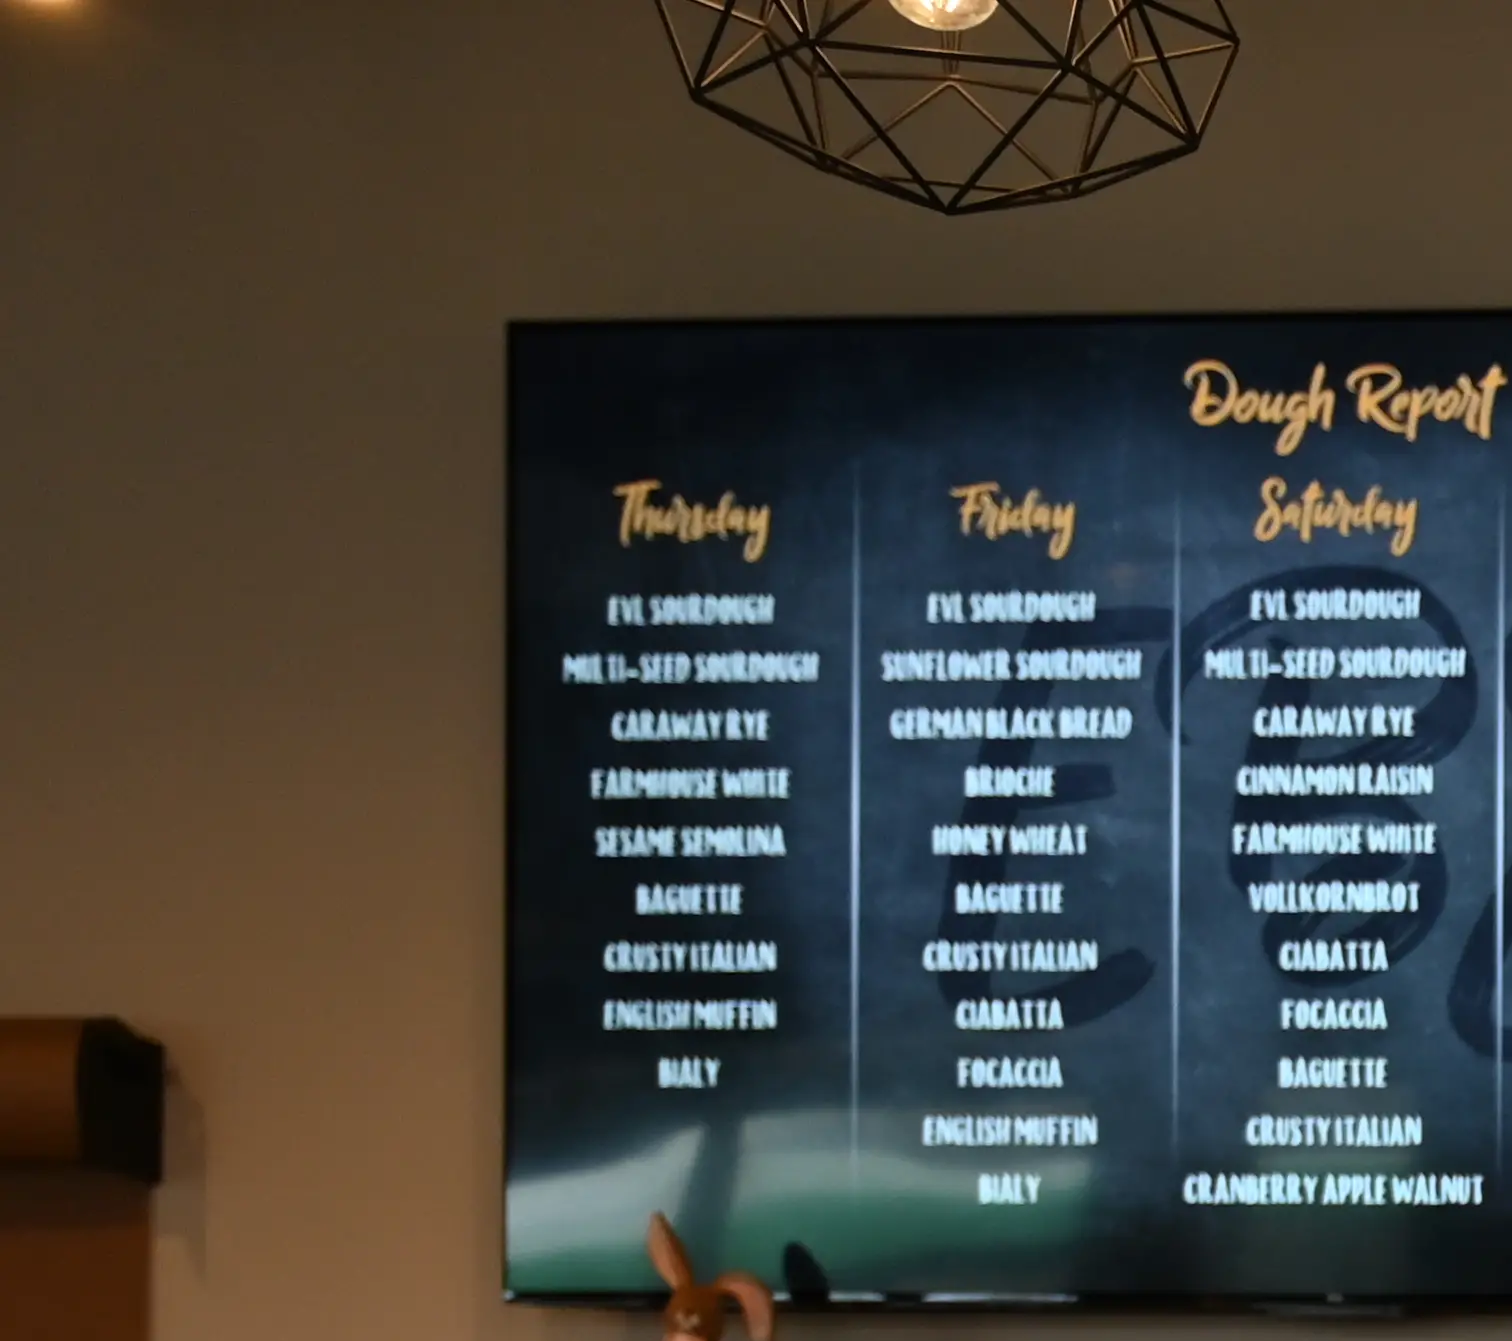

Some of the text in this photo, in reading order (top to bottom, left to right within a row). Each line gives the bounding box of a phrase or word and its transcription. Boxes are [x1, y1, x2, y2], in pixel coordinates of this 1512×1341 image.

[1185, 358, 1509, 458] Dough Report
[613, 479, 769, 563] Thursday
[951, 480, 1077, 561] Friday
[1255, 475, 1418, 558] Saturday
[1253, 704, 1415, 737] CARAWAY RYE
[1236, 763, 1434, 796] CINNAMON RAISIN
[1232, 822, 1437, 855] FARMHOUSE WHITE
[1248, 880, 1419, 913] VOLLKORNBROT
[1183, 1173, 1483, 1205] CRANBERRY APPLE WALNUT
